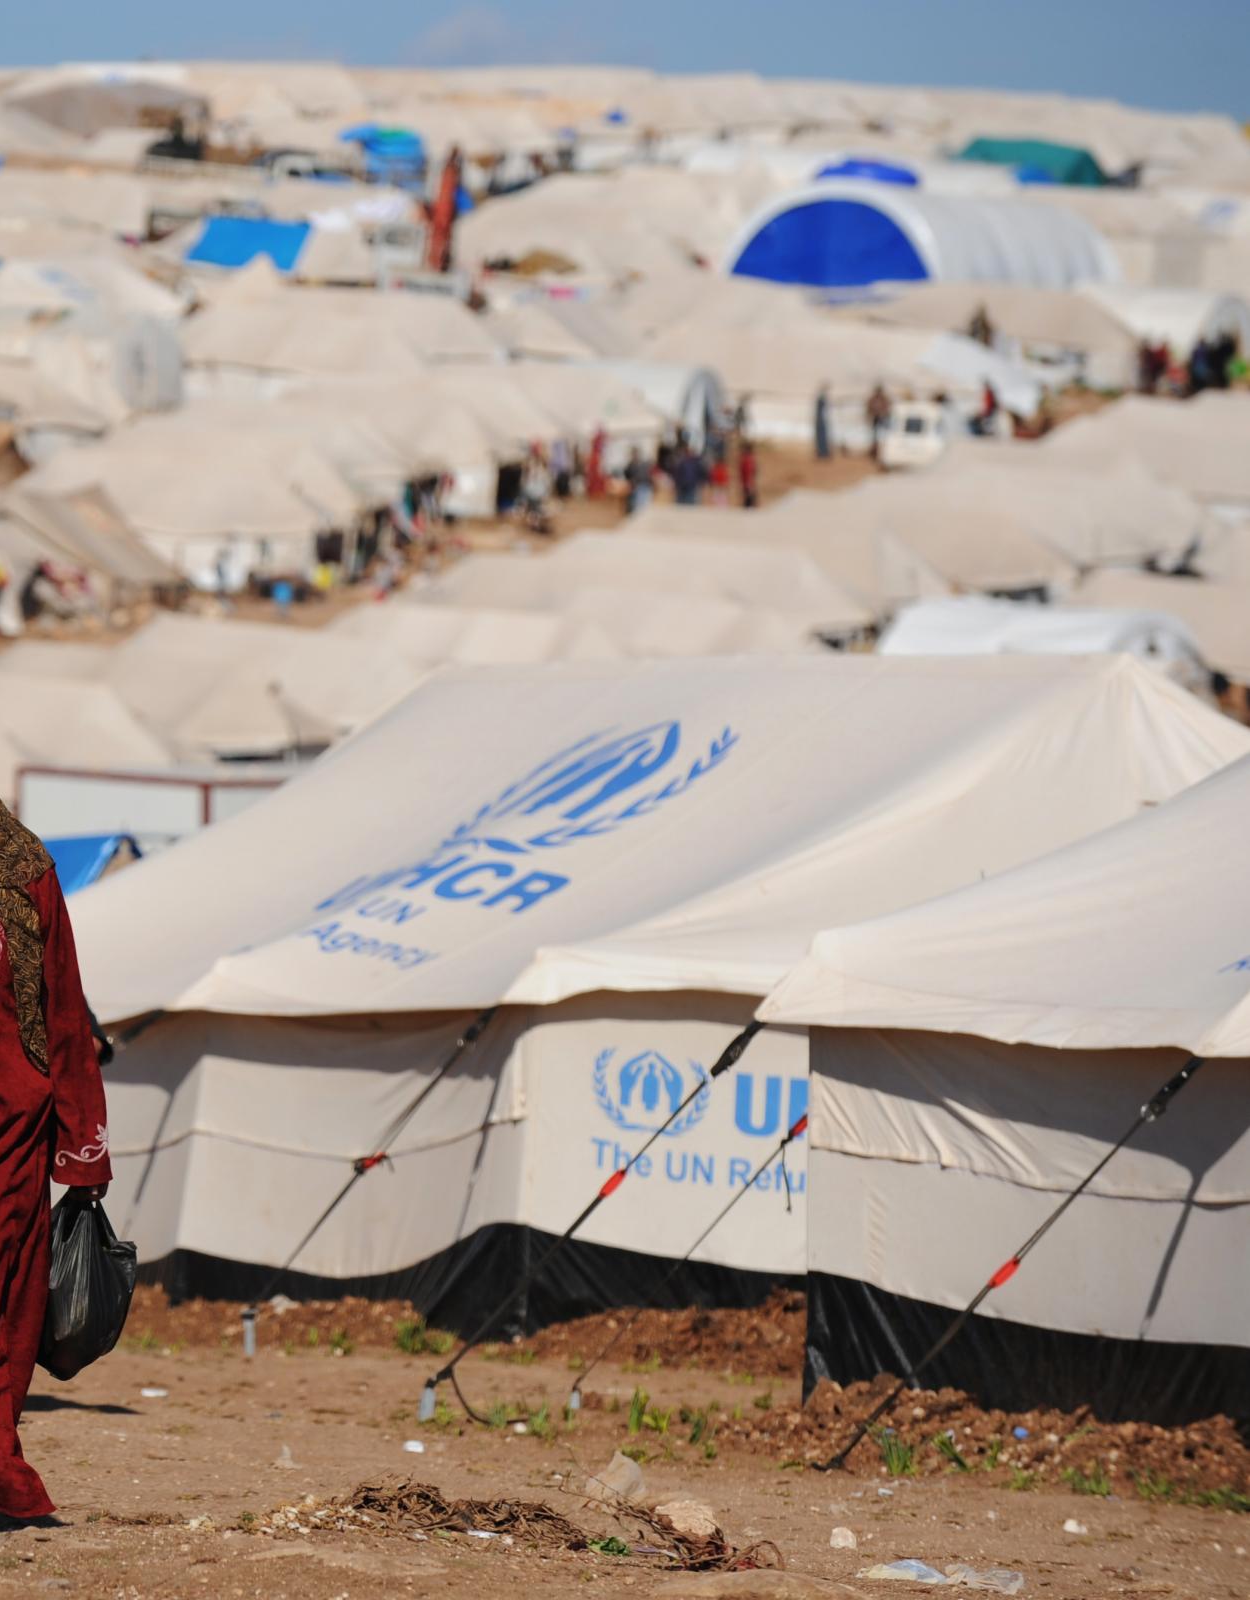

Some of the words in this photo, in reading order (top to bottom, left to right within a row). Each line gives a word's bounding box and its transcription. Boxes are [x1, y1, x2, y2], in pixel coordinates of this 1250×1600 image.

[356, 896, 427, 924] UN
[304, 921, 441, 970] Agency
[592, 1137, 652, 1177] The
[666, 1151, 714, 1185] UN
